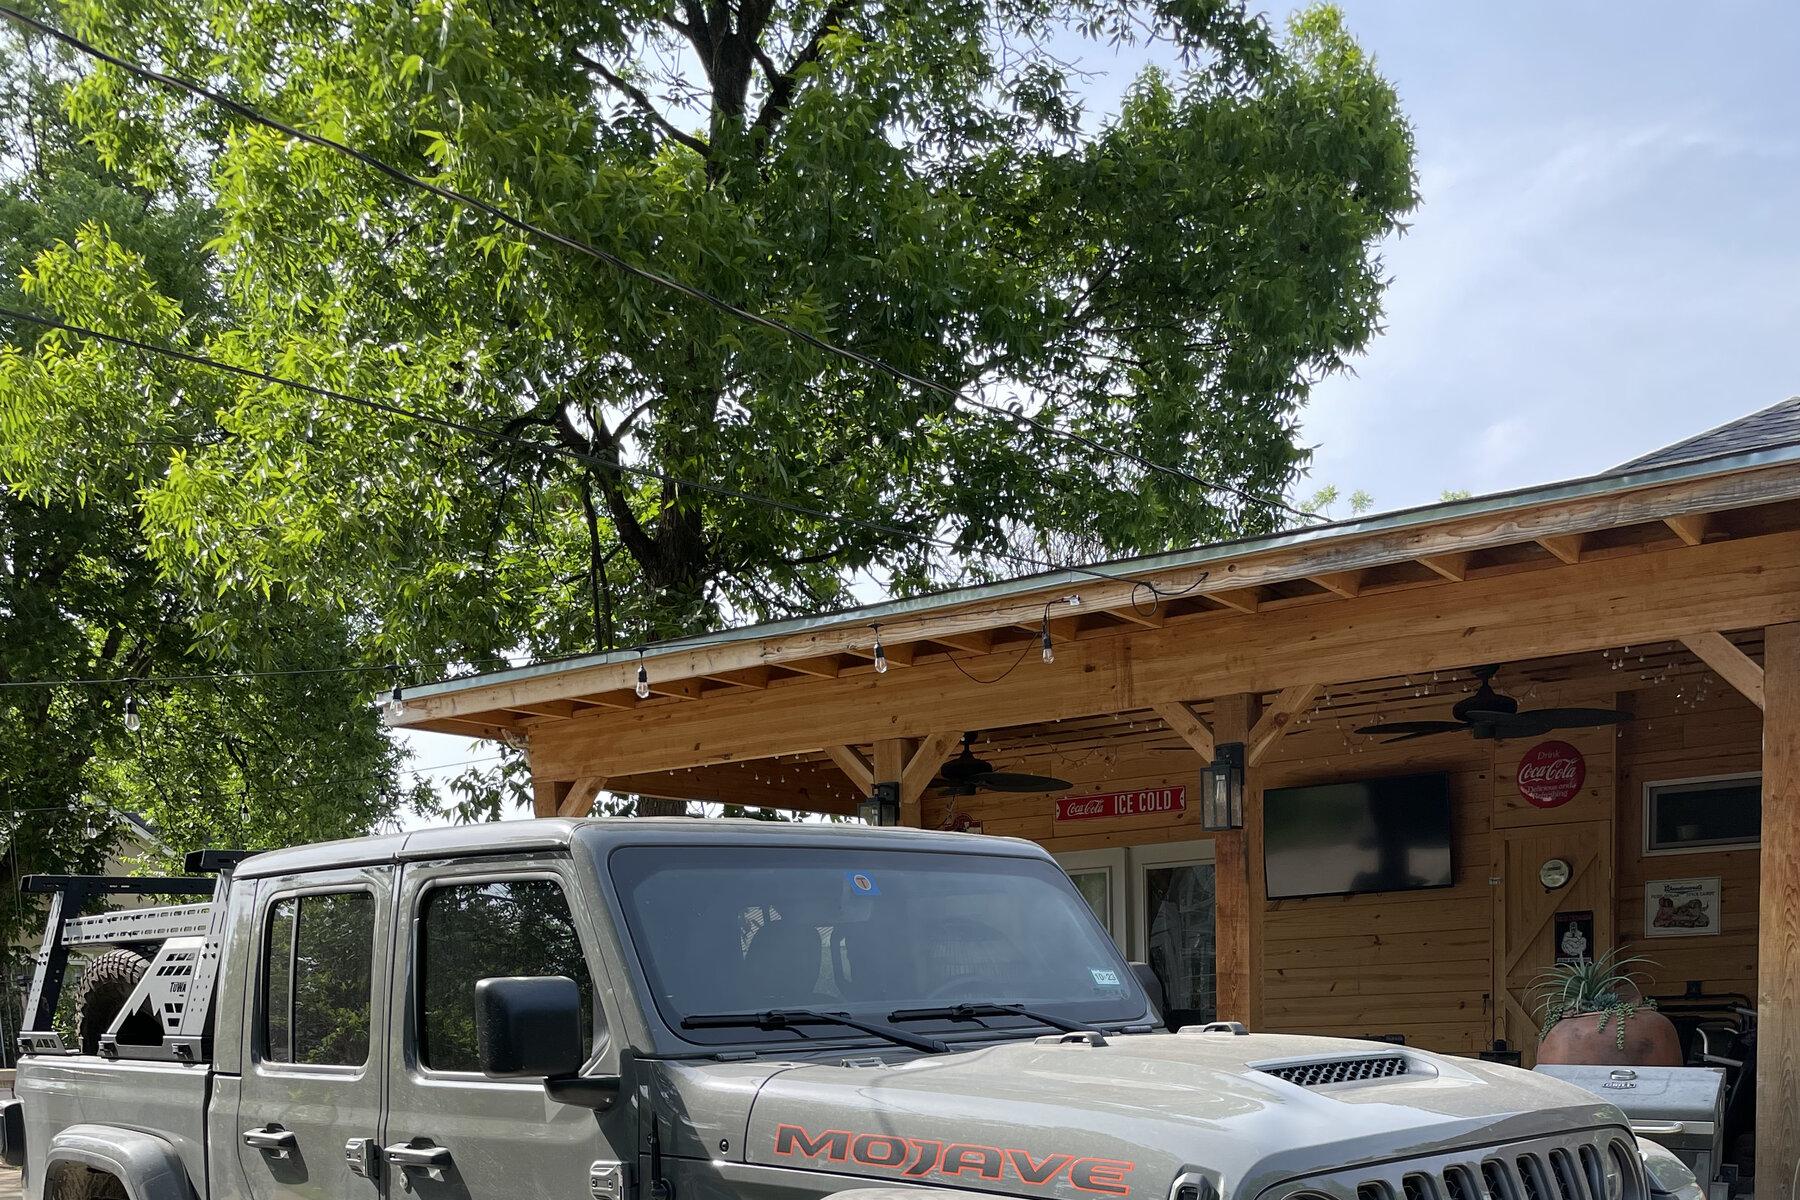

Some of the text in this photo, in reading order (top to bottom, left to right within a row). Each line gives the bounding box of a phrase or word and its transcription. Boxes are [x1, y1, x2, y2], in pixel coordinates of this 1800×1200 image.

[1519, 757, 1580, 784] Coca-Cola
[1114, 794, 1134, 815] ICE
[1139, 790, 1172, 812] COLD
[774, 1123, 1136, 1196] MOJAVE
